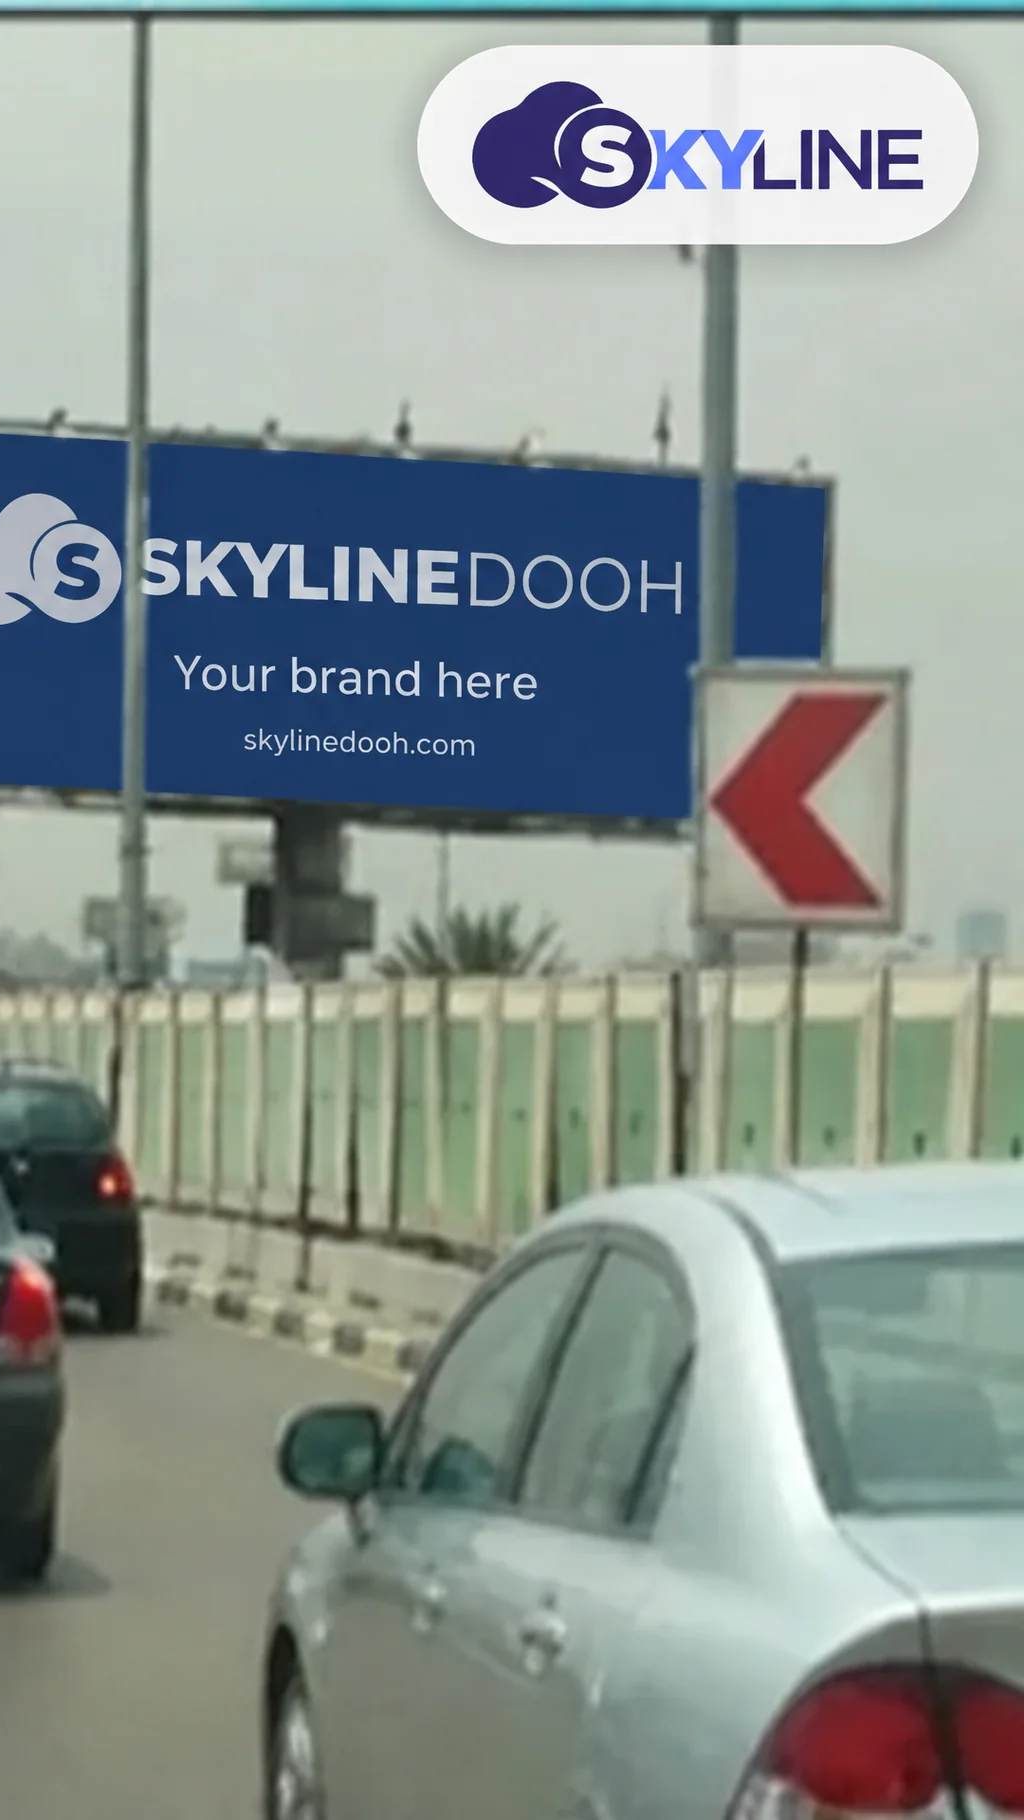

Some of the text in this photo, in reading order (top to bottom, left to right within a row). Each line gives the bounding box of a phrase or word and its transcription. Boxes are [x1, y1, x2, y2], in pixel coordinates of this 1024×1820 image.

[141, 537, 683, 614] SKYLINEDOOH
[174, 654, 538, 700] Your brand here
[243, 728, 476, 757] skylinedooh.com
